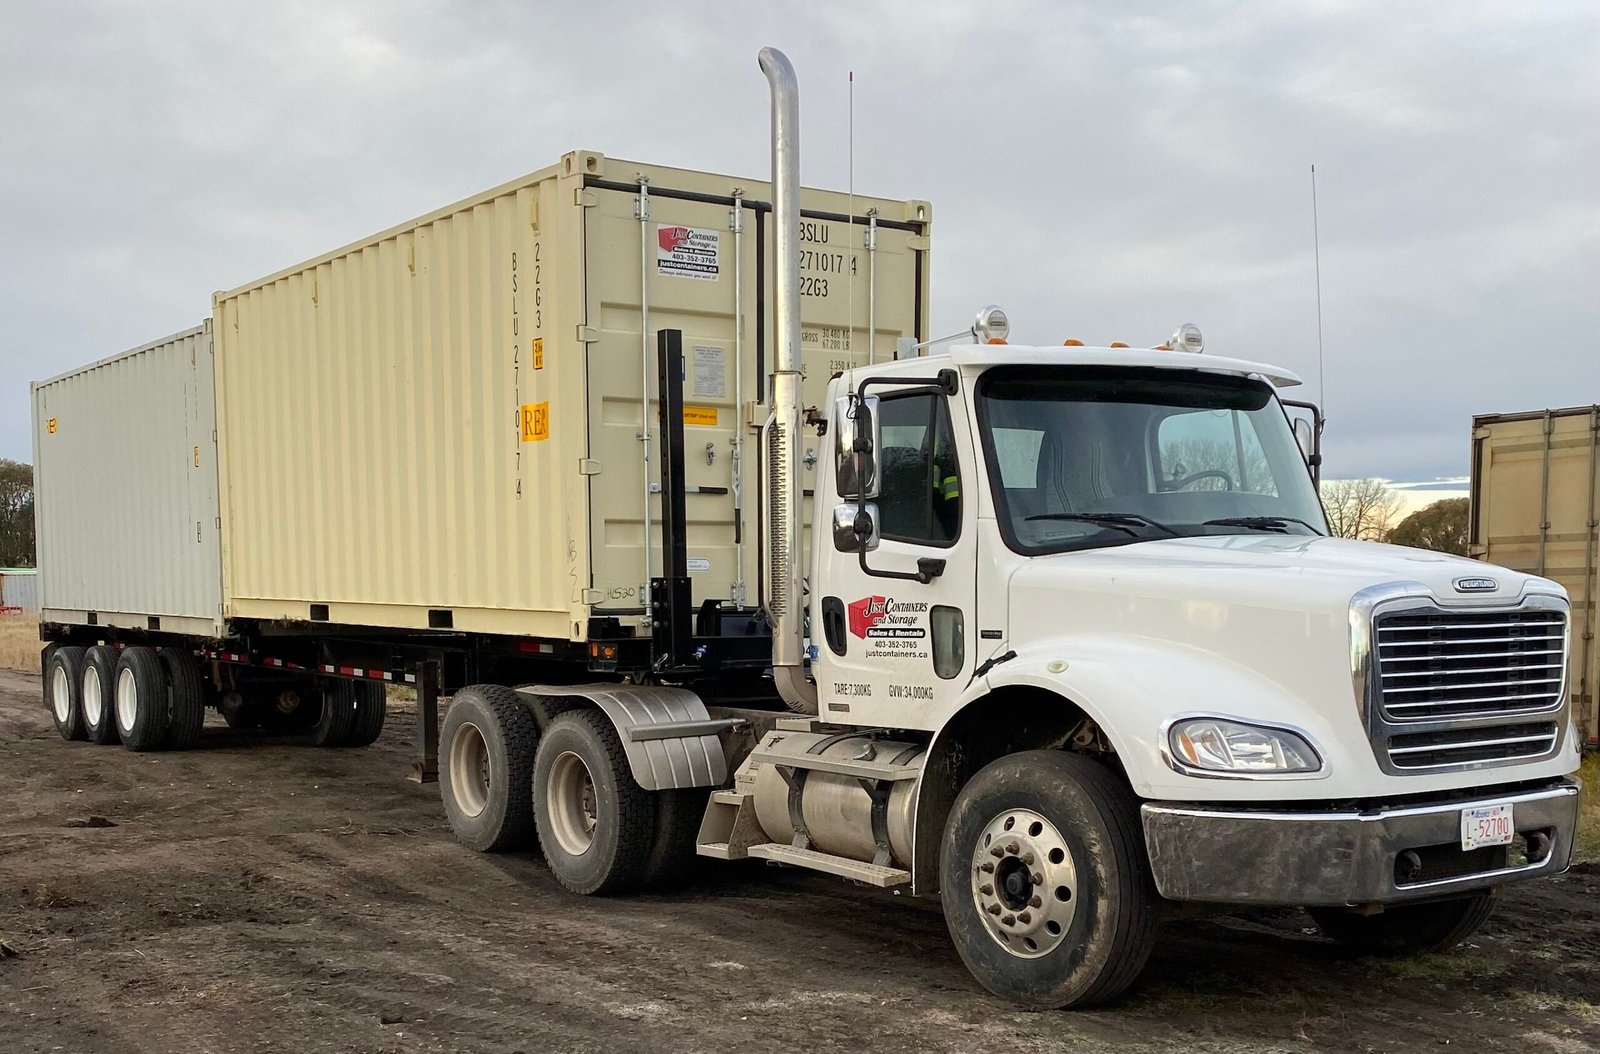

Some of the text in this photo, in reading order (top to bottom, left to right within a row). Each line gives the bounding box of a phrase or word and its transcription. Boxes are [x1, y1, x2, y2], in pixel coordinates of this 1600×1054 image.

[672, 254, 717, 265] 403-352-3765
[800, 250, 857, 275] 271017 4
[660, 260, 717, 272] justcontainers.ca
[800, 276, 828, 297] 22G3
[885, 598, 928, 614] CONTAINERS
[873, 614, 918, 626] and Storage
[868, 629, 924, 637] Sales & Rentals
[874, 641, 918, 649] 403-352-3765
[865, 650, 928, 658] justcontainers.ca
